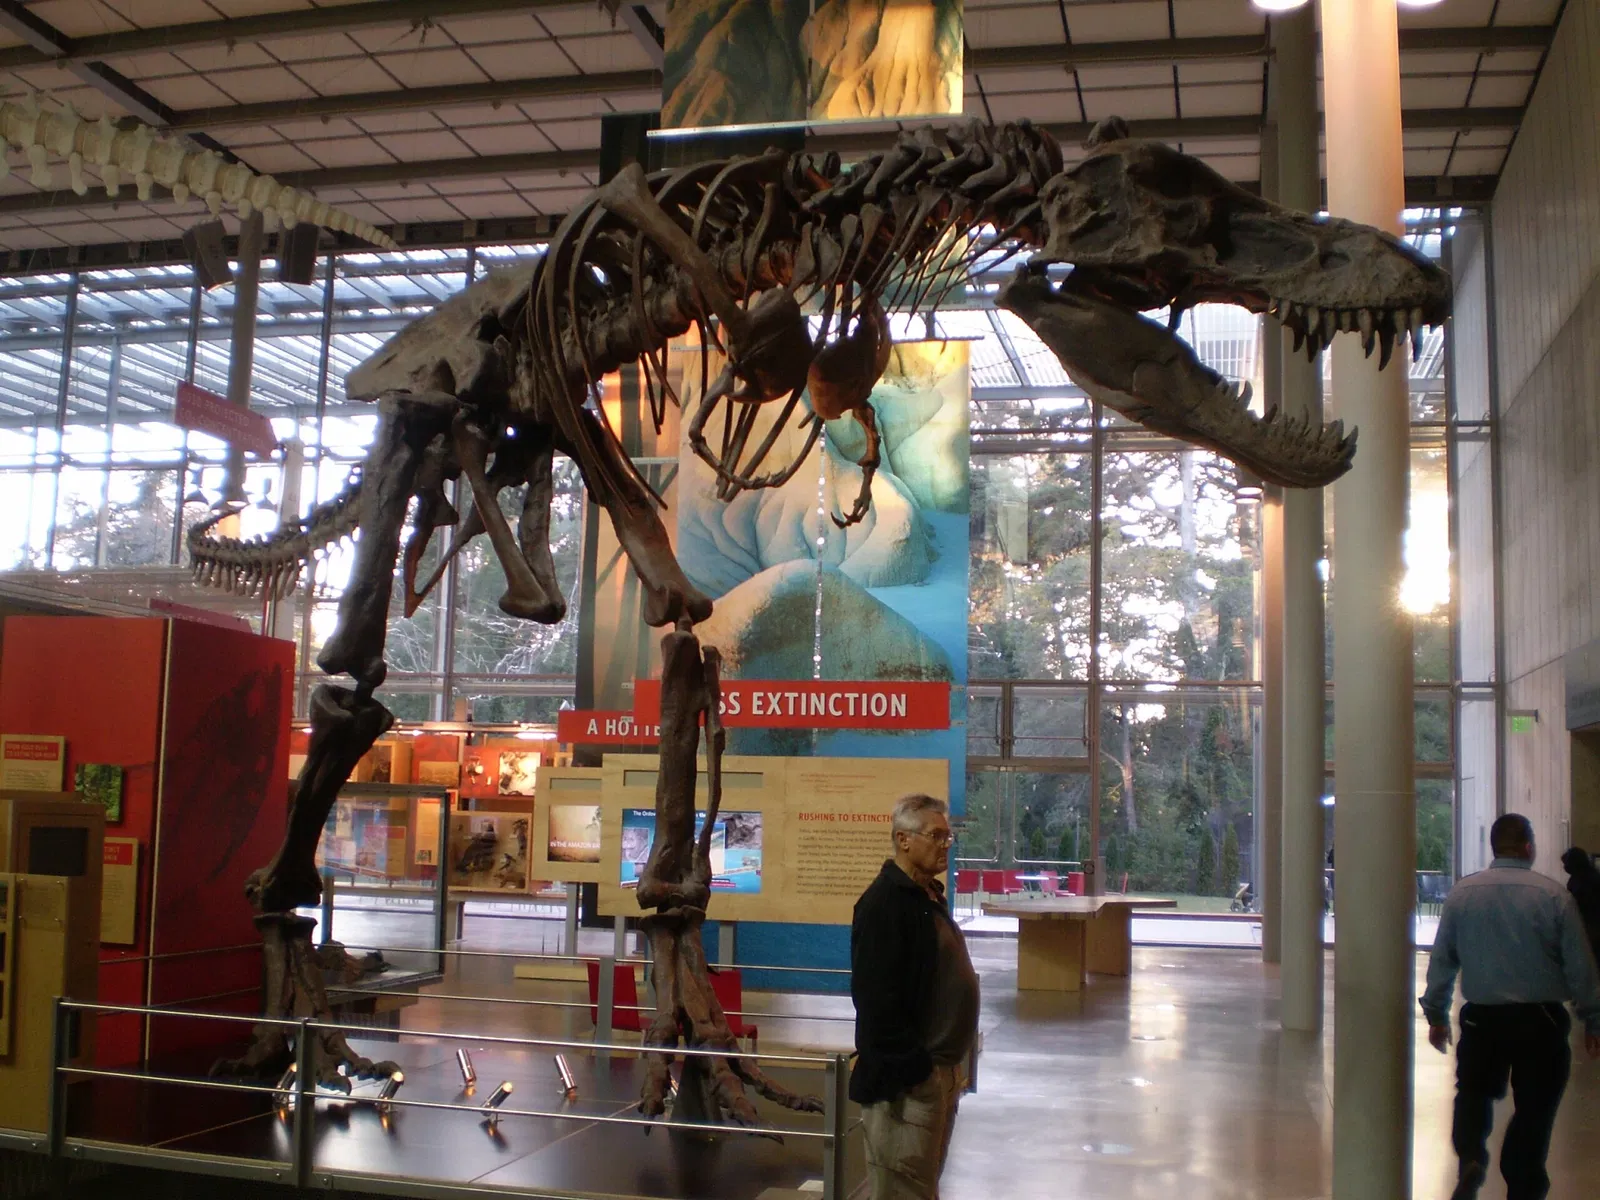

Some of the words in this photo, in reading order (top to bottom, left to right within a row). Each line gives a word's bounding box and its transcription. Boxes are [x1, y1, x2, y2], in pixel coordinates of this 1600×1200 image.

[752, 692, 907, 717] EXTINCTION
[586, 718, 598, 735] A
[798, 813, 835, 822] RUSHING
[838, 813, 849, 822] TO
